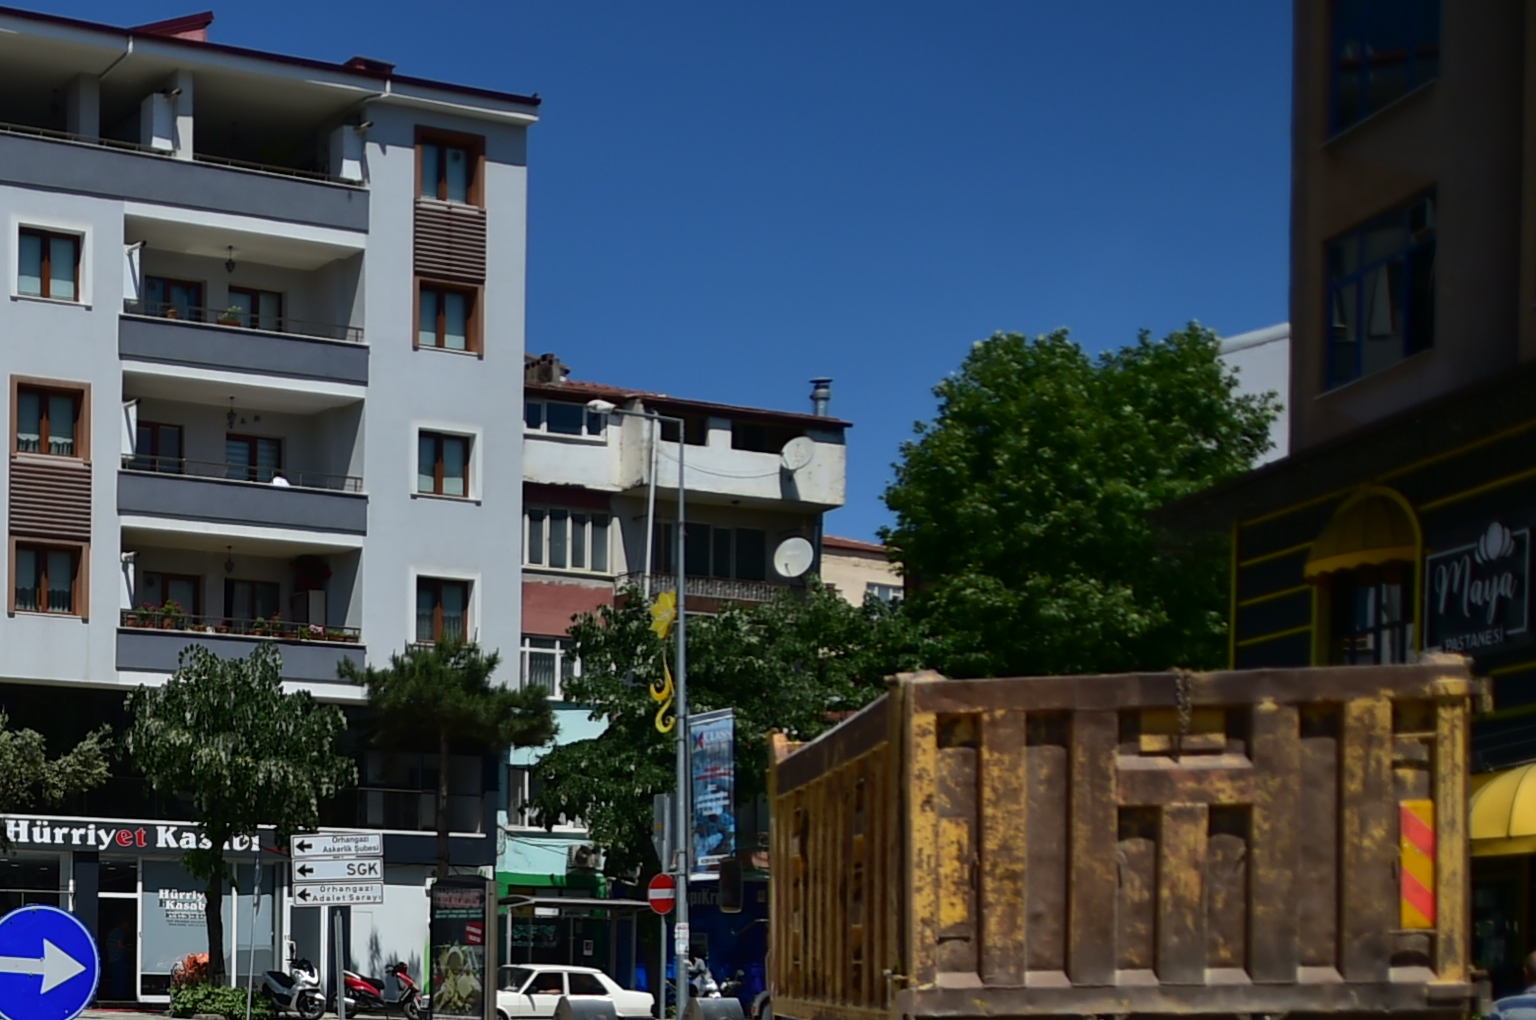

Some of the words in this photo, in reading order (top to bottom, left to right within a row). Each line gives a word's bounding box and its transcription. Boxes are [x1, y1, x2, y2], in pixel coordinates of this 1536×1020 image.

[1435, 554, 1516, 625] Maya
[1445, 625, 1504, 650] PASTANESİ
[5, 819, 147, 850] Hürriyet
[332, 836, 369, 844] Orhangazi
[354, 844, 379, 854] Şubesi
[346, 862, 379, 876] SGK
[158, 889, 206, 901] Hürriy
[312, 894, 346, 902] Adalet
[349, 894, 381, 902] Sarayı
